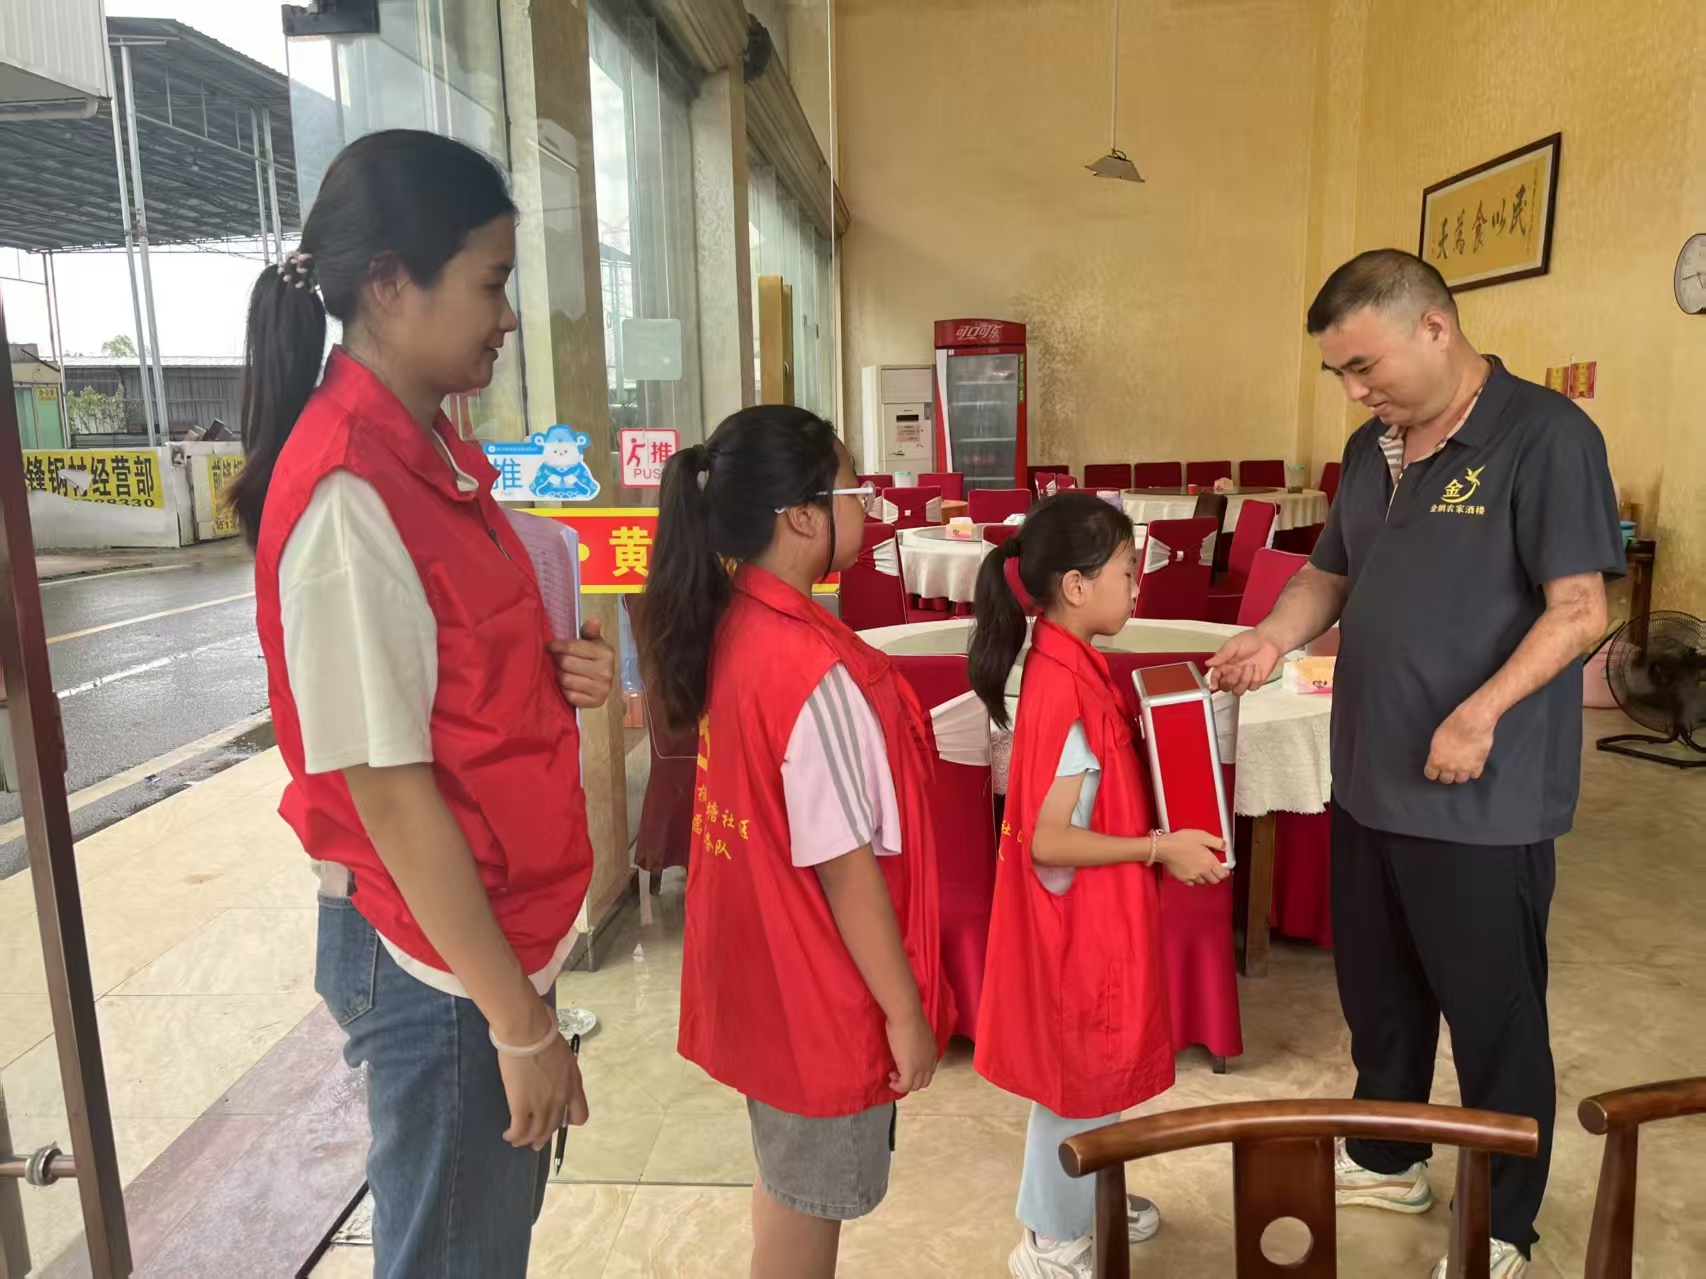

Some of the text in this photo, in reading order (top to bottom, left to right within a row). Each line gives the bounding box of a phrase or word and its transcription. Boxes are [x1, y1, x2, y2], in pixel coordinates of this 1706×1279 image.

[956, 324, 1004, 340] 可口可乐
[651, 442, 672, 463] 推
[491, 458, 523, 491] 推
[634, 469, 662, 479] PUS
[1442, 479, 1464, 497] 金
[609, 526, 652, 577] 黄
